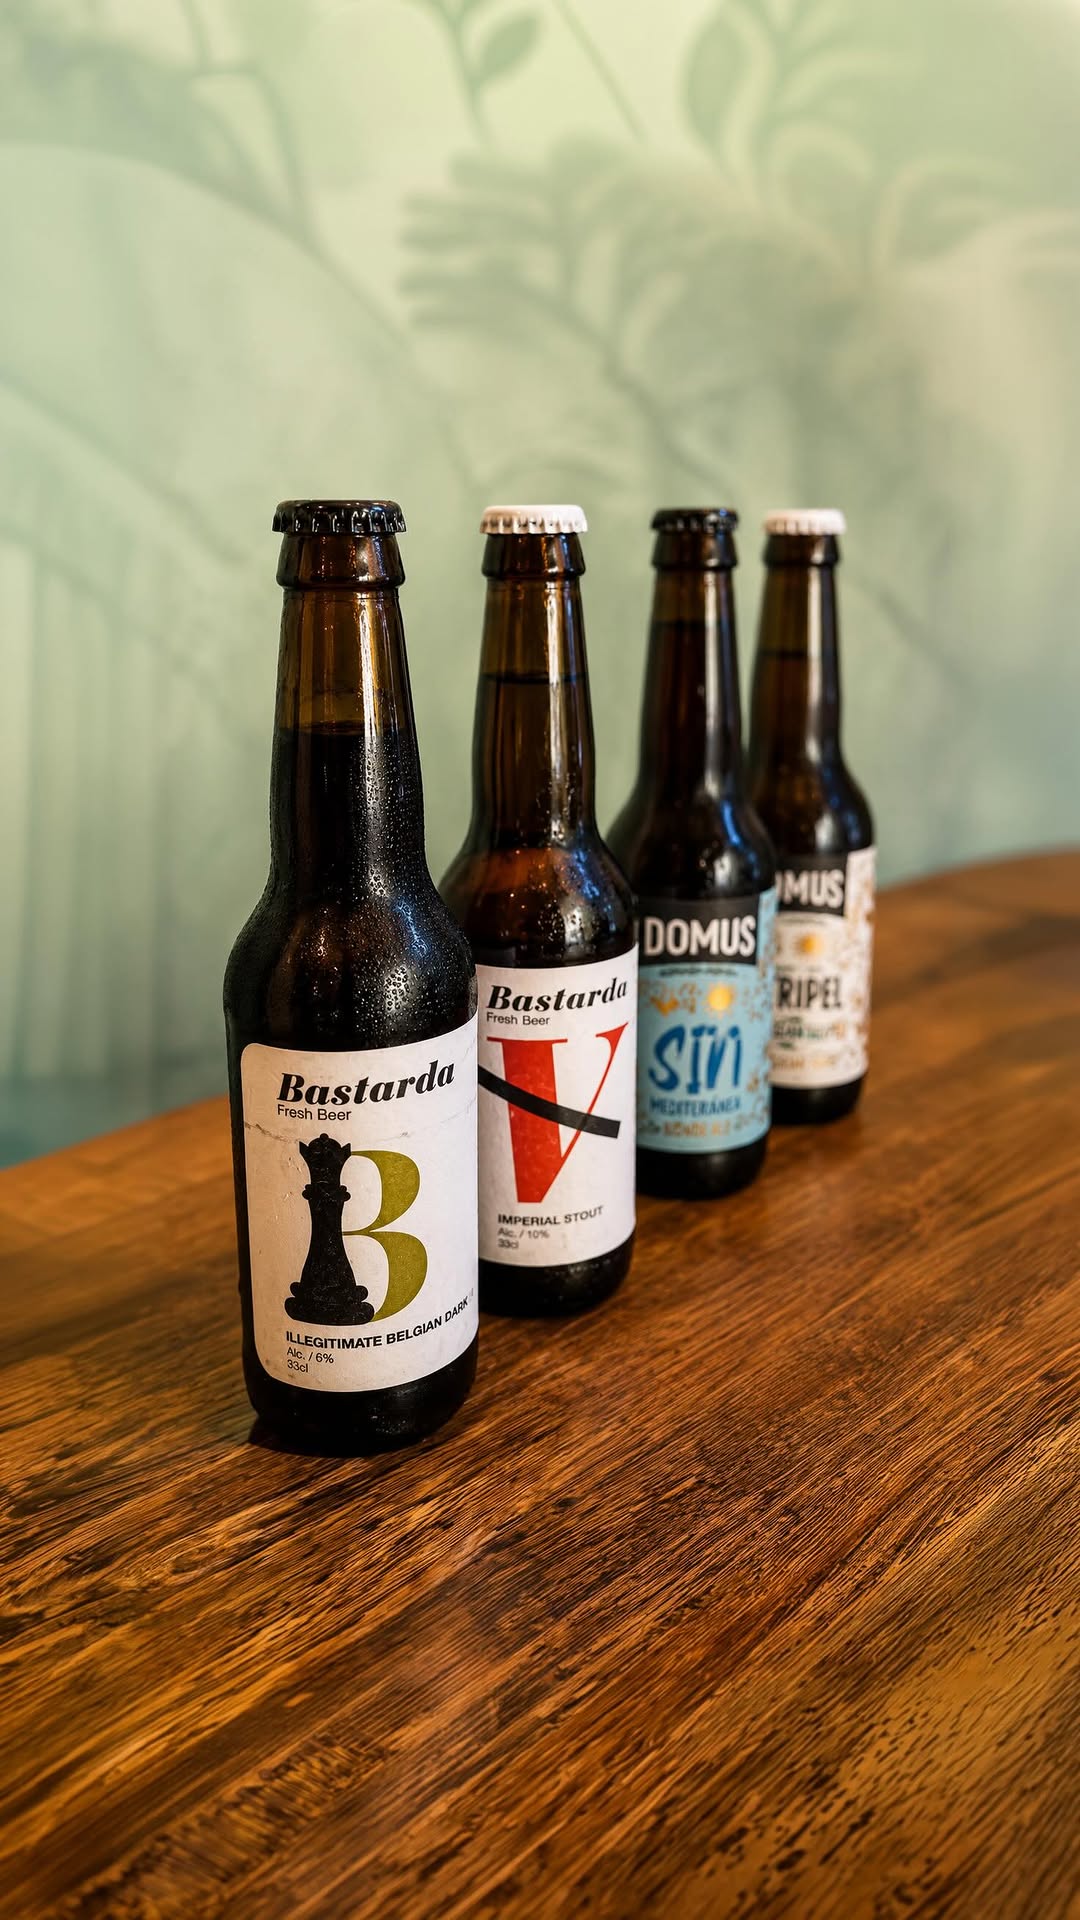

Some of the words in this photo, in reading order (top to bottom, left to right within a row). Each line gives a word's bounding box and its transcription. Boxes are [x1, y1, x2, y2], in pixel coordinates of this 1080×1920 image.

[776, 869, 845, 908] MUS
[644, 915, 756, 957] DOMUS
[486, 977, 628, 1012] Bastarda
[777, 976, 842, 1009] RIPEL
[486, 1012, 518, 1025] Fresh
[522, 1015, 550, 1026] Beer
[276, 1059, 455, 1105] Bastarda
[277, 1104, 313, 1120] Fresh
[317, 1108, 352, 1121] Beer
[498, 1214, 561, 1226] IMPERIAL
[564, 1206, 605, 1224] STOUT
[498, 1228, 517, 1238] Alc.
[527, 1229, 549, 1239] 10%
[286, 1331, 383, 1349] ILLEGITIMATE
[386, 1316, 442, 1344] BELGIAN
[445, 1296, 468, 1322] DARK
[287, 1347, 306, 1361] Alc.
[308, 1352, 313, 1362] /
[315, 1352, 334, 1364] 6%
[287, 1359, 308, 1373] 33cl
